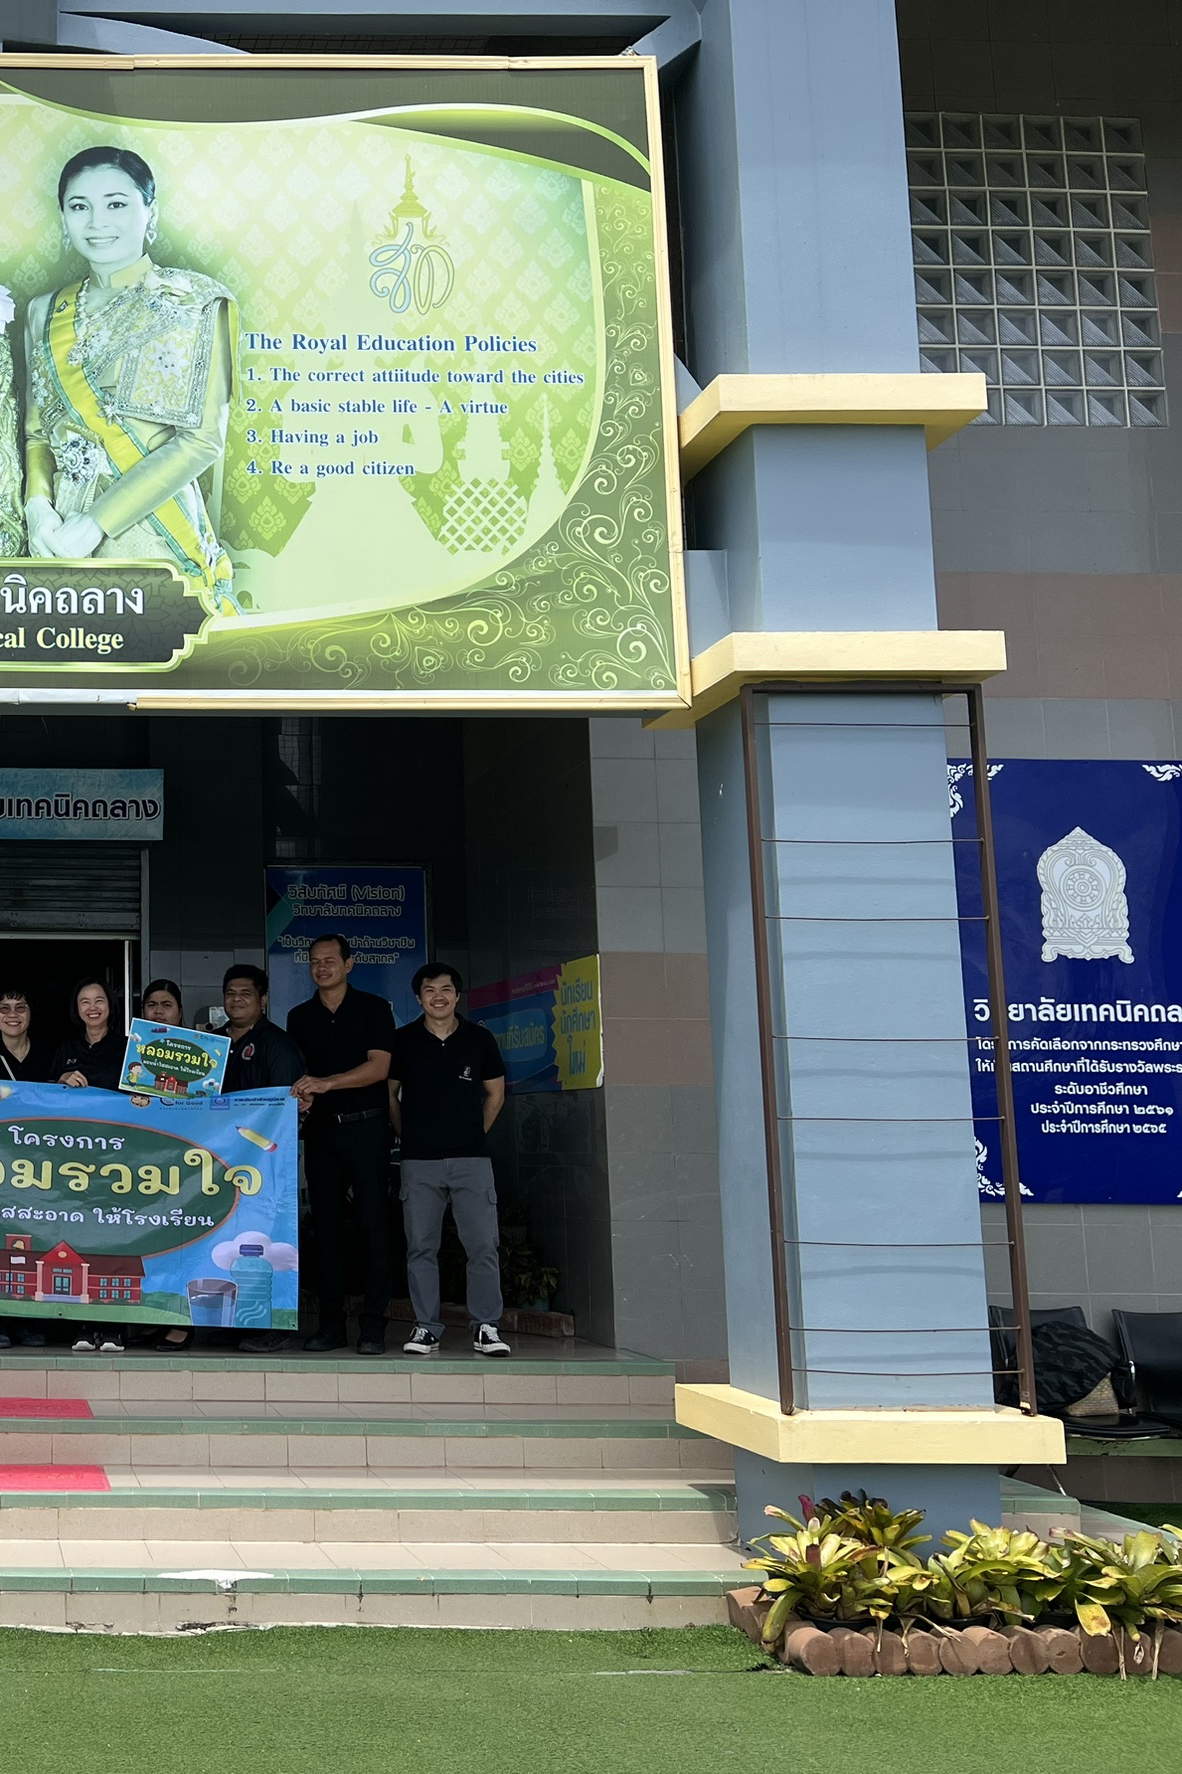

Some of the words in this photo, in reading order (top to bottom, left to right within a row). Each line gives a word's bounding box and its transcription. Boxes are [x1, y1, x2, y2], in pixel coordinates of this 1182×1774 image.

[245, 333, 283, 350] The
[292, 334, 347, 354] Royal
[356, 334, 455, 351] Education
[464, 336, 537, 352] Policies
[246, 368, 261, 381] 1.
[270, 368, 301, 382] The
[308, 370, 365, 383] correct
[447, 370, 504, 384] toward
[511, 370, 536, 384] the
[543, 371, 584, 385] cities
[246, 398, 262, 412] 2.
[270, 399, 283, 413] A
[291, 399, 331, 413] basic
[338, 399, 385, 414] stable
[393, 399, 418, 414] life
[439, 401, 452, 414] A
[461, 401, 508, 415] virtue
[246, 429, 262, 443] 3.
[271, 429, 329, 448] Having
[336, 433, 345, 444] a
[352, 430, 379, 448] job
[246, 460, 262, 474] 4.
[300, 464, 309, 475] a
[316, 461, 355, 478] good
[363, 461, 415, 476] citizen
[37, 626, 124, 655] College
[351, 885, 406, 901] (Vision)
[135, 1043, 218, 1069] หลอมรวมใจ
[1054, 1081, 1148, 1095] ระดับอาชีวศึกษา
[1030, 1101, 1130, 1115] ประจำปีการศึกษา
[1041, 1119, 1131, 1134] ประจำปีการศึกษา
[9, 1126, 124, 1151] โครงการ
[94, 1206, 215, 1229] ให้โรงเรียน
